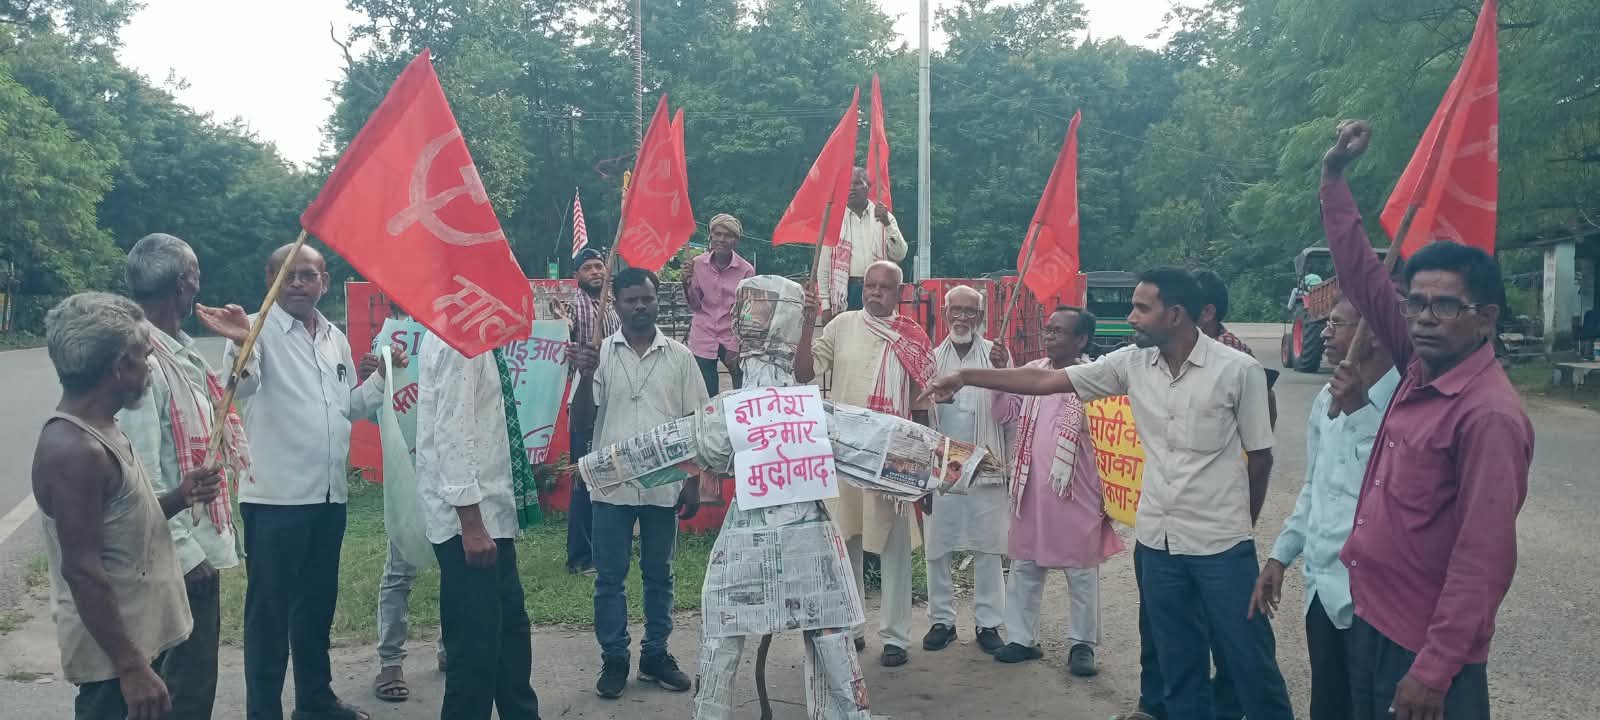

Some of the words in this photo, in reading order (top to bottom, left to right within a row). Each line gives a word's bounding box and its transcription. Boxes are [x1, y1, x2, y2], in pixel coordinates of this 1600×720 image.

[433, 274, 530, 345] माले
[735, 387, 814, 425] ज्ञानेश
[747, 420, 818, 451] कुमार
[1088, 405, 1127, 448] मोदी
